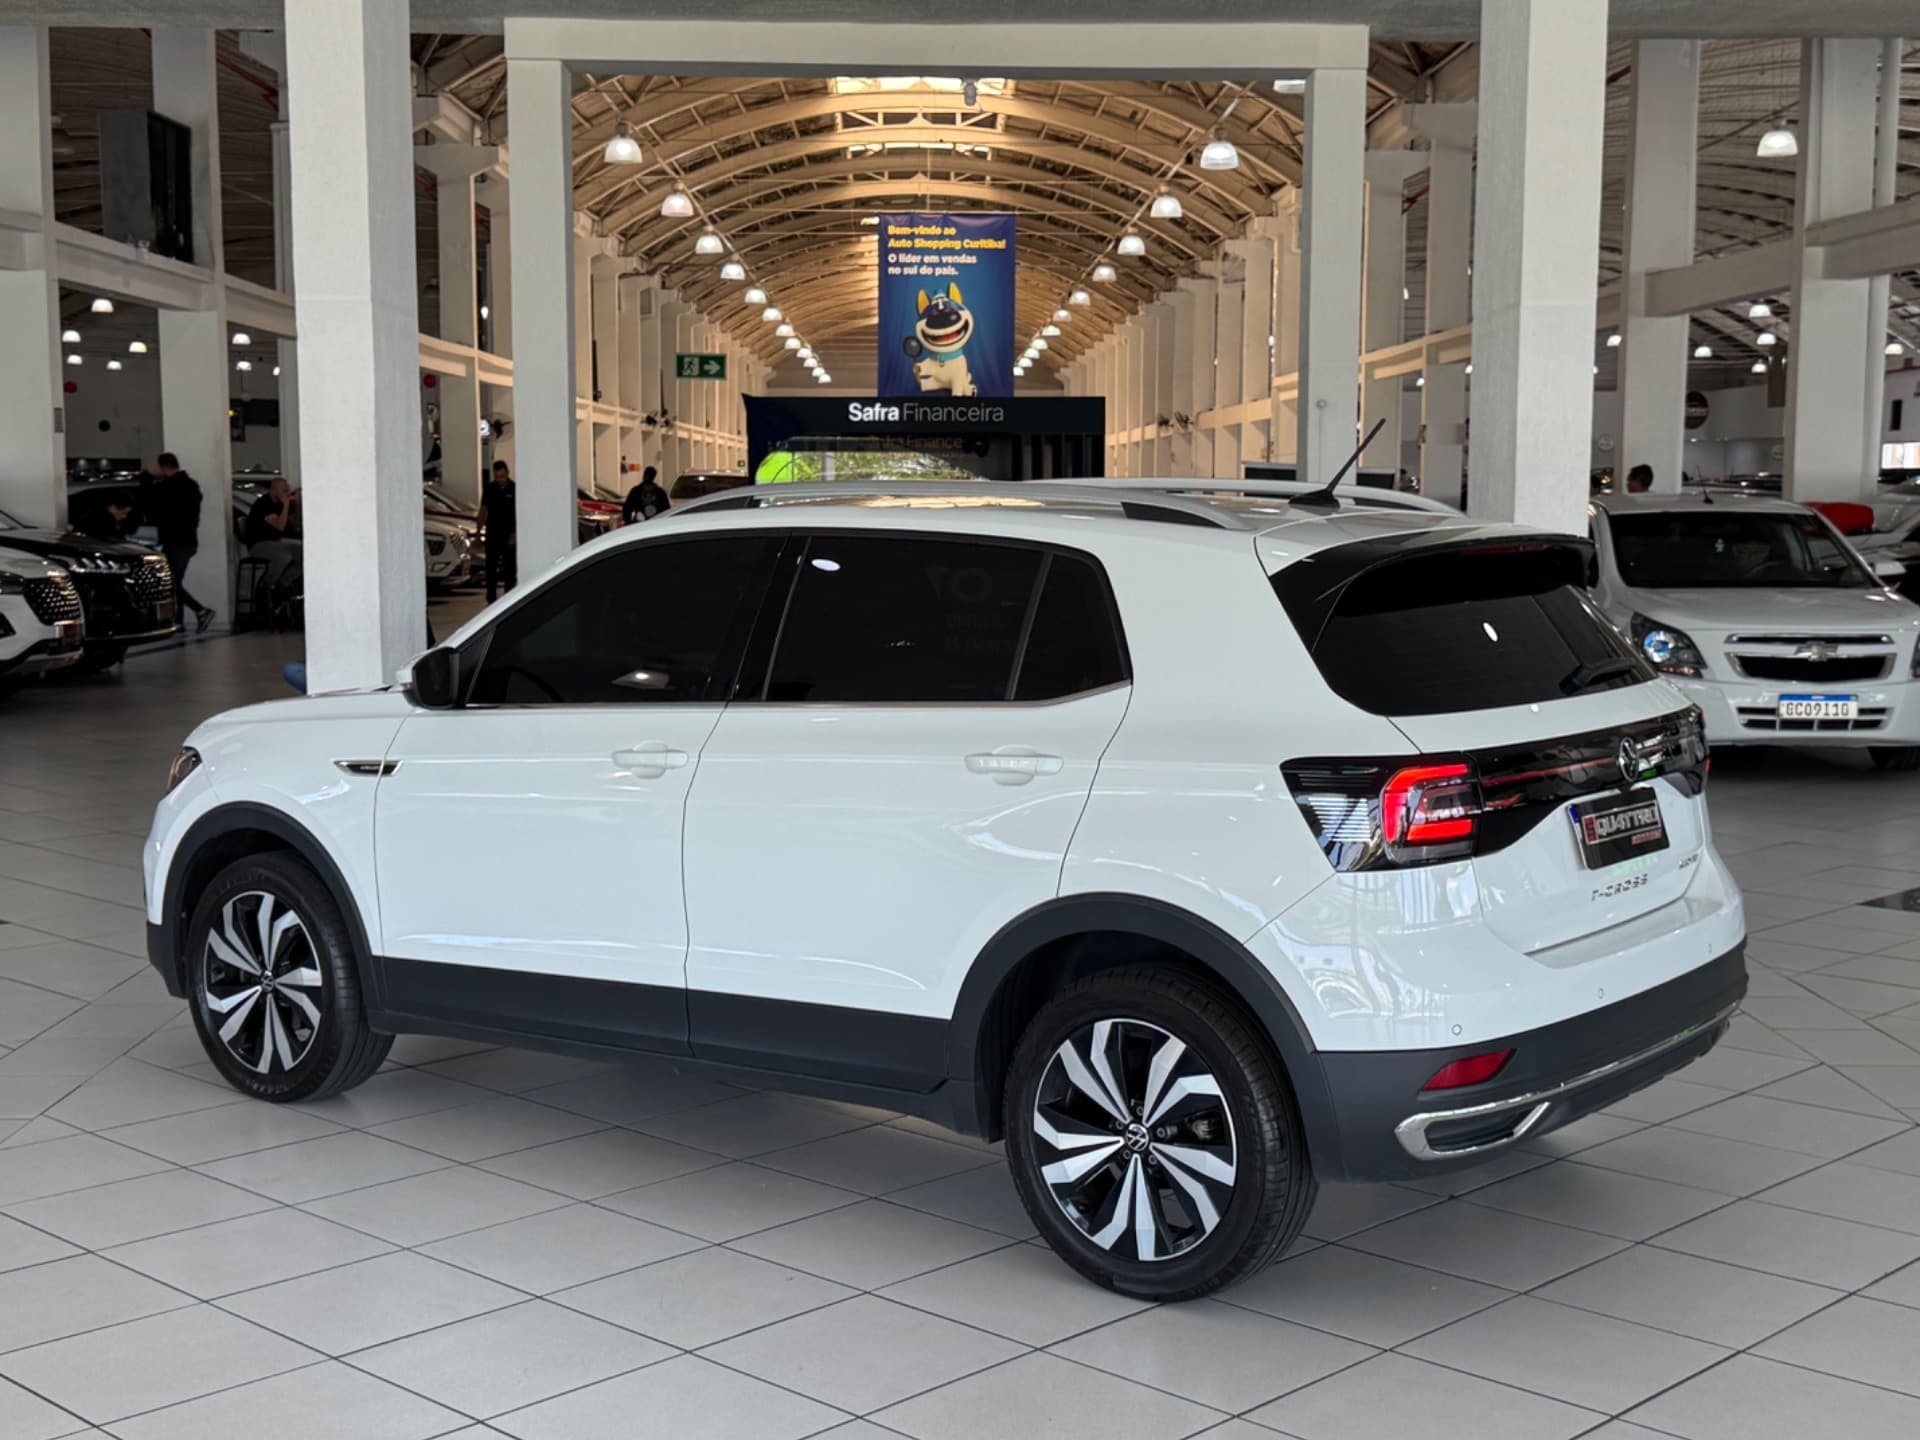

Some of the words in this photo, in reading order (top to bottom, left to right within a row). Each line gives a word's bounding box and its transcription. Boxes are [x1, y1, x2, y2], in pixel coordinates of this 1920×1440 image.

[888, 225, 942, 235] Bem-vindo
[943, 227, 957, 235] ao
[888, 238, 913, 248] Auto
[914, 238, 961, 250] Shopping
[963, 238, 1006, 249] Curitiba!
[888, 253, 897, 263] O
[923, 255, 940, 263] em
[941, 254, 977, 263] vendas
[888, 266, 901, 274] no
[903, 265, 918, 274] sul
[919, 265, 933, 274] do
[848, 402, 900, 422] Safra
[903, 402, 1004, 422] Financeira
